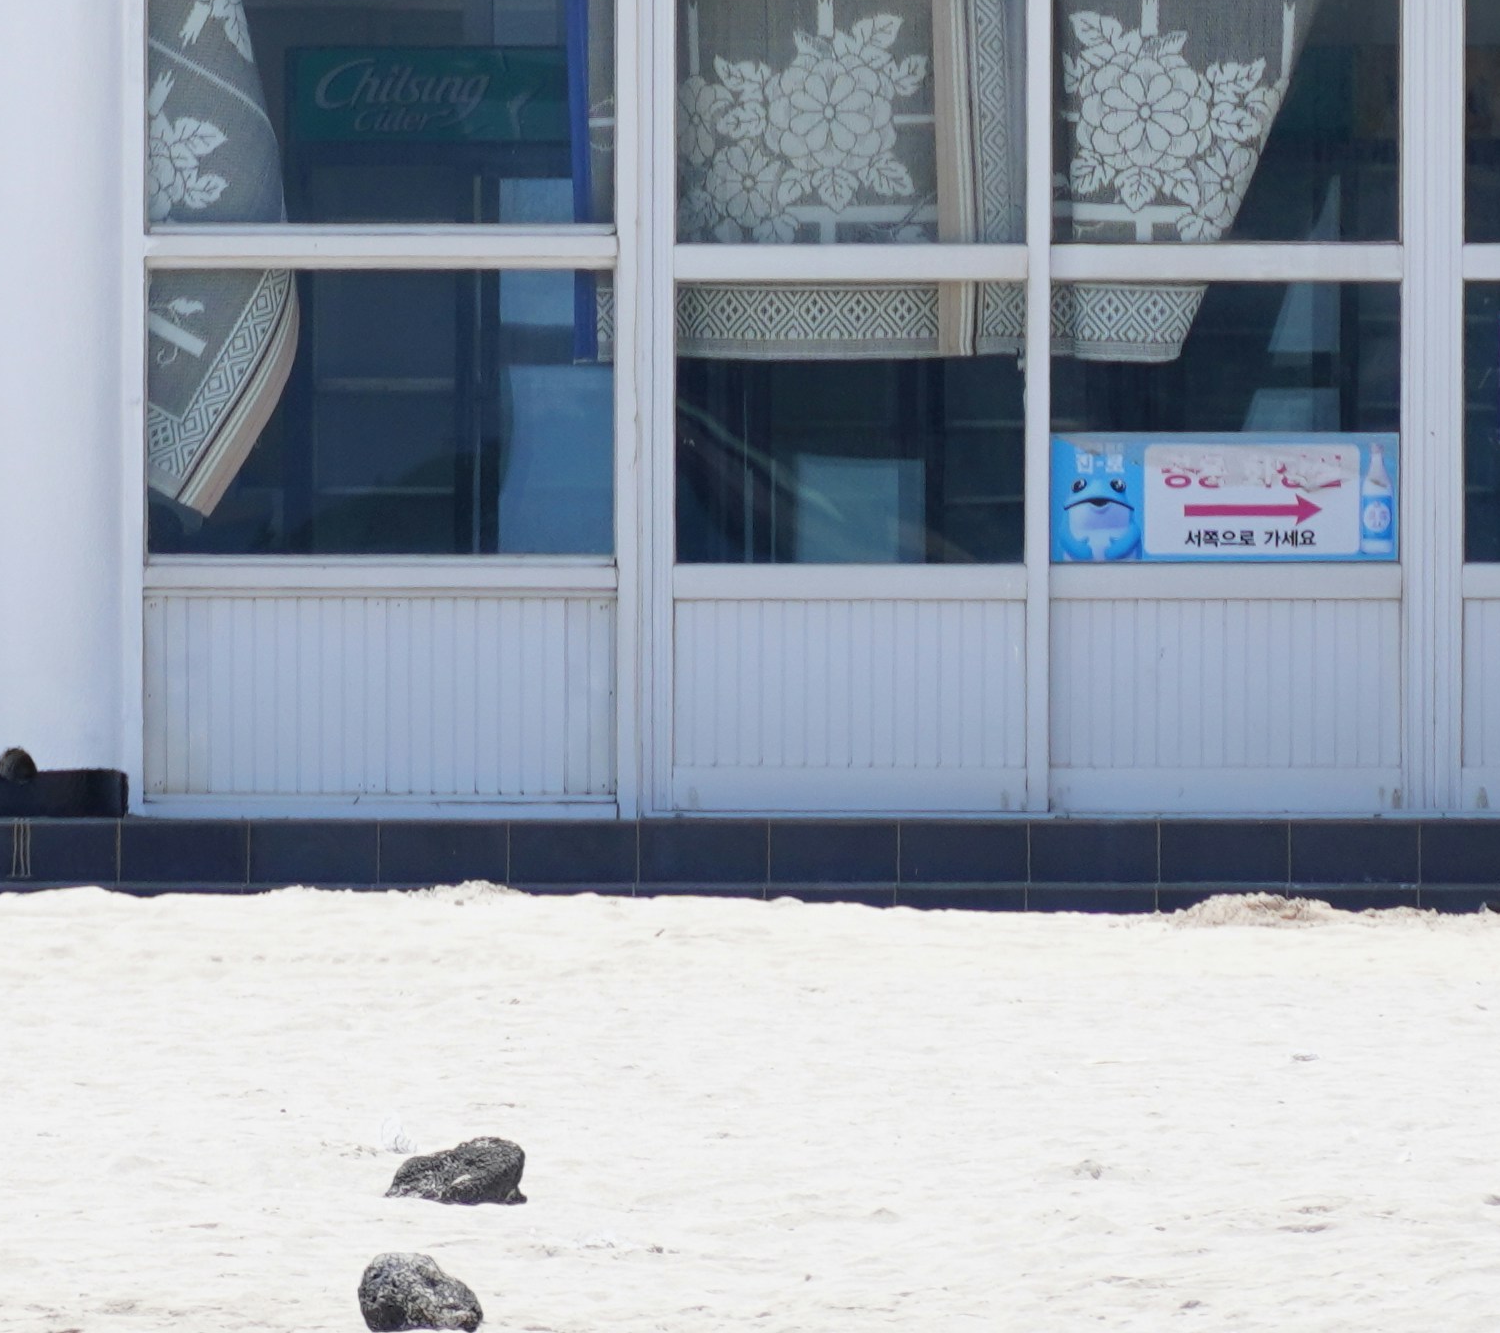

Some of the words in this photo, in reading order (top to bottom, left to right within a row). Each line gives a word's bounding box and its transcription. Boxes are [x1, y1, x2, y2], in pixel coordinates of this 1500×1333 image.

[314, 58, 490, 125] Chilsung
[353, 106, 440, 132] Cider
[1184, 529, 1257, 548] 서쪽으로
[1263, 529, 1318, 548] 가세요
